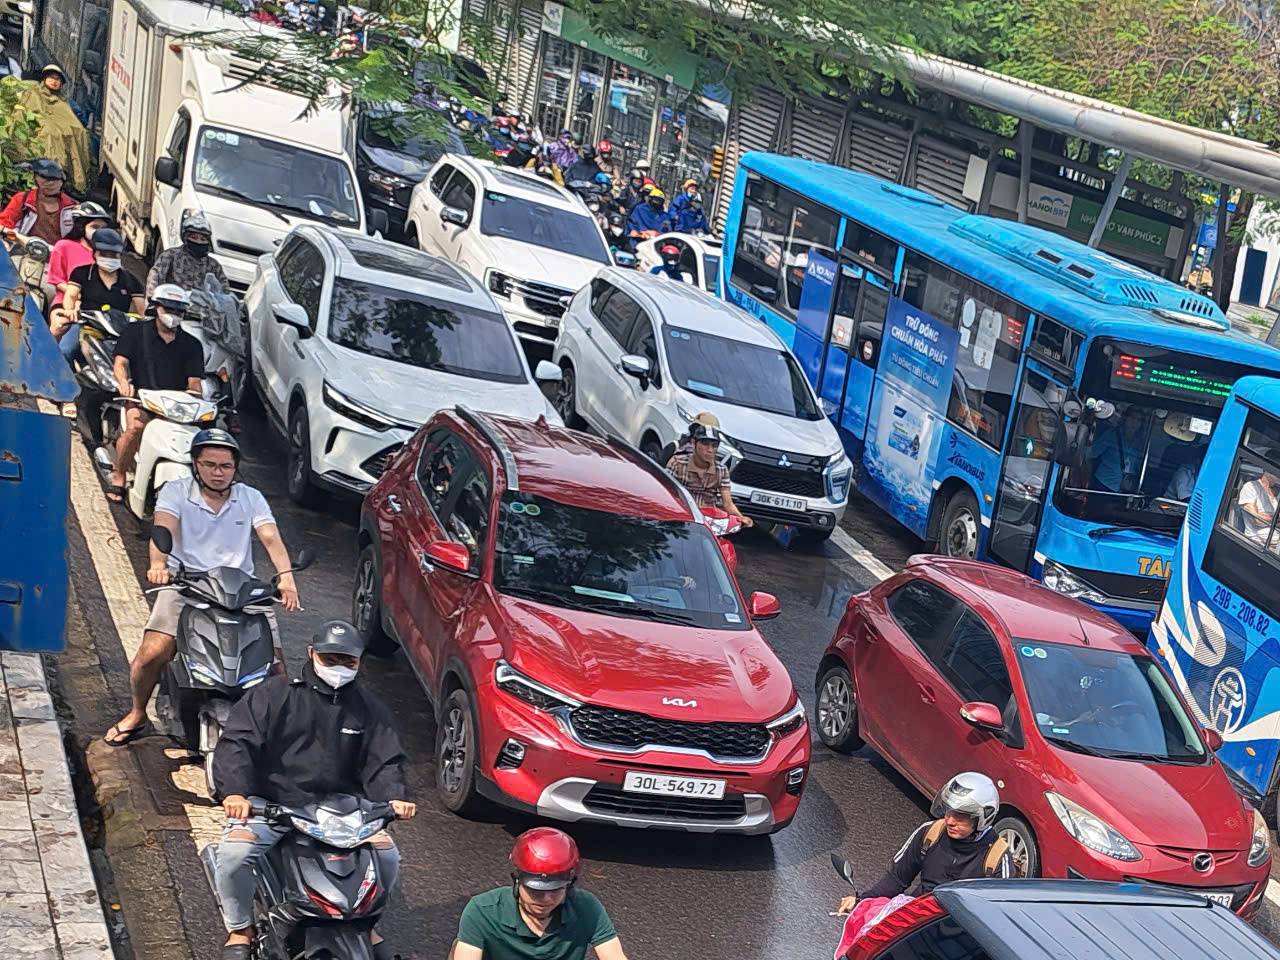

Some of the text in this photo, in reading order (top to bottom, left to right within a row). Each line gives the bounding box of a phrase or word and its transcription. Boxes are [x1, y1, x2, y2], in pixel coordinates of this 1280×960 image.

[754, 493, 802, 509] 30K-611.10
[1212, 585, 1232, 610] 29B
[1236, 602, 1270, 637] 208.82
[633, 776, 717, 796] 30L-549.72
